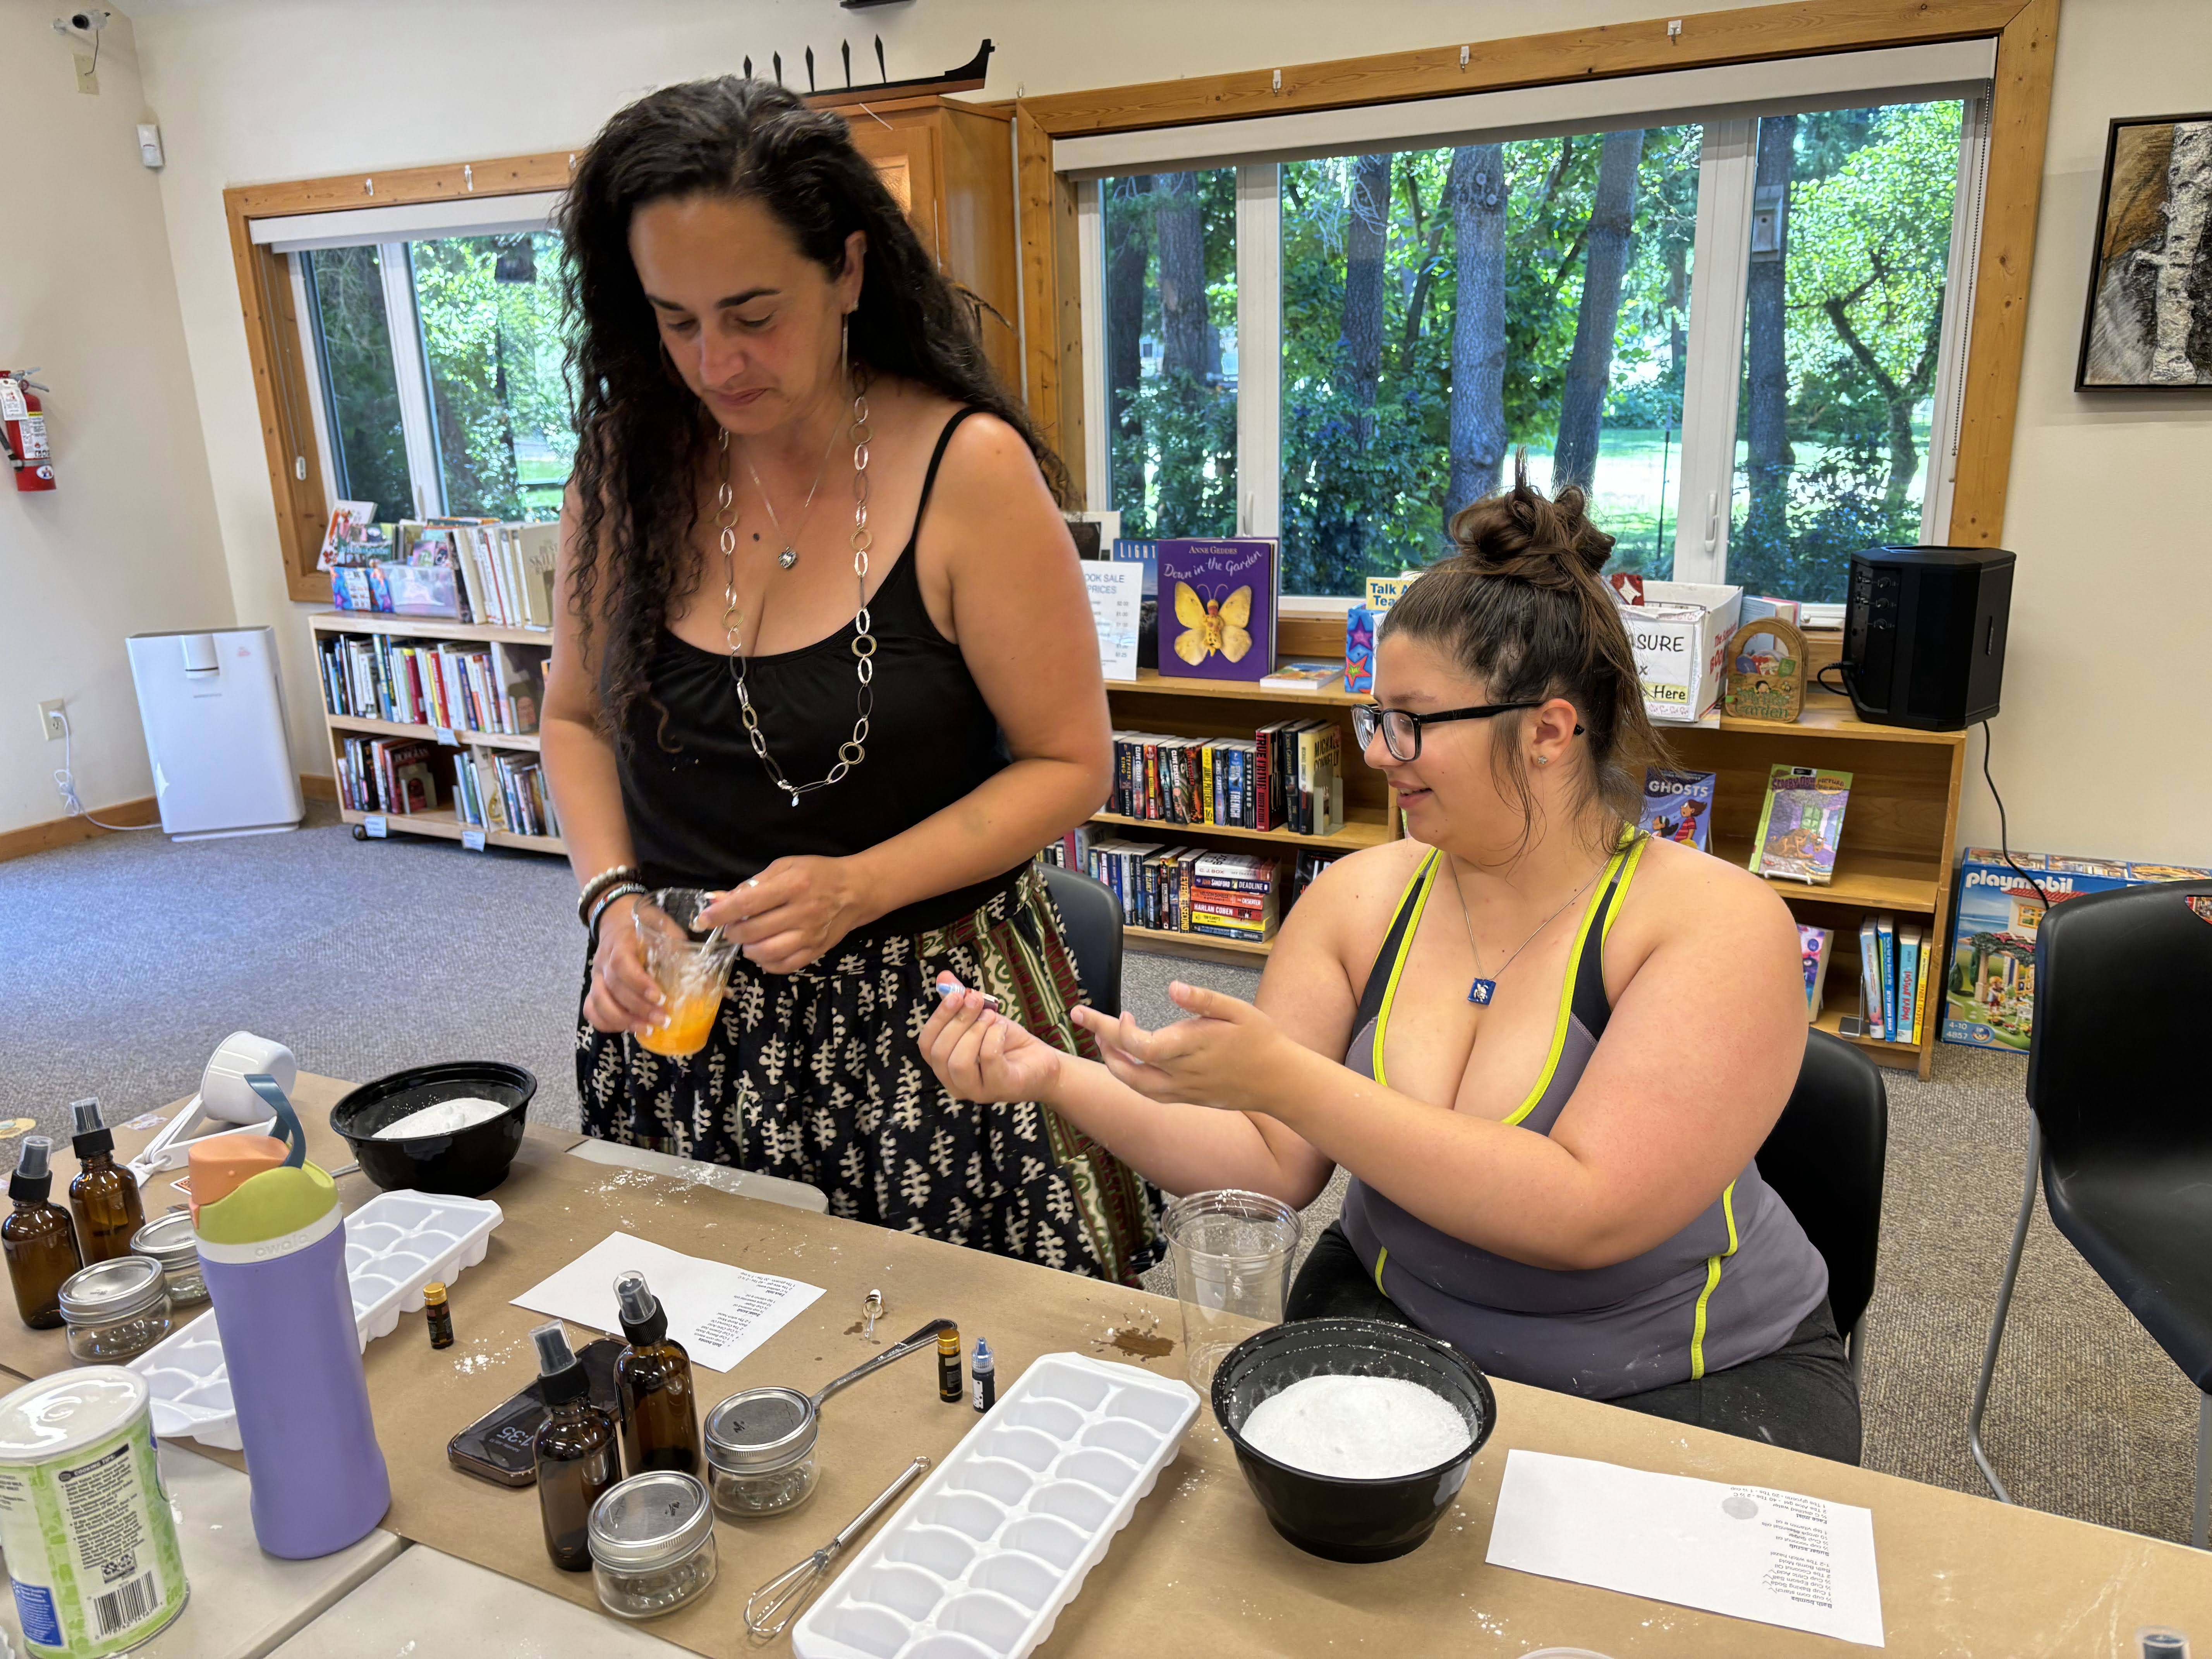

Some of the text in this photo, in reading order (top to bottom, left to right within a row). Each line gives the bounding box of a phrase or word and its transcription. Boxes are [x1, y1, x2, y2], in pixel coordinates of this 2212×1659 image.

[1120, 542, 1155, 559] LIGHT
[1189, 546, 1237, 555] ANNE GEDDES
[1163, 550, 1262, 580] Down in the Garden
[1085, 574, 1125, 583] OOK SALE
[1087, 586, 1116, 594] PRICES
[1370, 583, 1396, 595] Talk
[1654, 685, 1686, 700] Here
[1257, 734, 1266, 758] TRUE
[1203, 767, 1212, 808] JAMES PATTERSON
[1649, 780, 1708, 797] GHOSTS
[1230, 791, 1240, 818] TRENCH
[1211, 879, 1230, 888] SANDFORD
[1239, 881, 1263, 890] DEADLINE
[1965, 869, 2073, 893] playmobil
[1194, 903, 1233, 915] HARLAN COBEN
[1181, 907, 1189, 930] SECOND
[1902, 971, 1913, 997] INSTANT
[1901, 998, 1911, 1021] KARMA
[254, 1232, 310, 1258] owala
[1773, 1524, 1800, 1534] essential
[1784, 1538, 1808, 1546] coconut
[1785, 1566, 1811, 1575] Coconut
[1789, 1583, 1810, 1592] Baking
[1791, 1596, 1814, 1605] bombs
